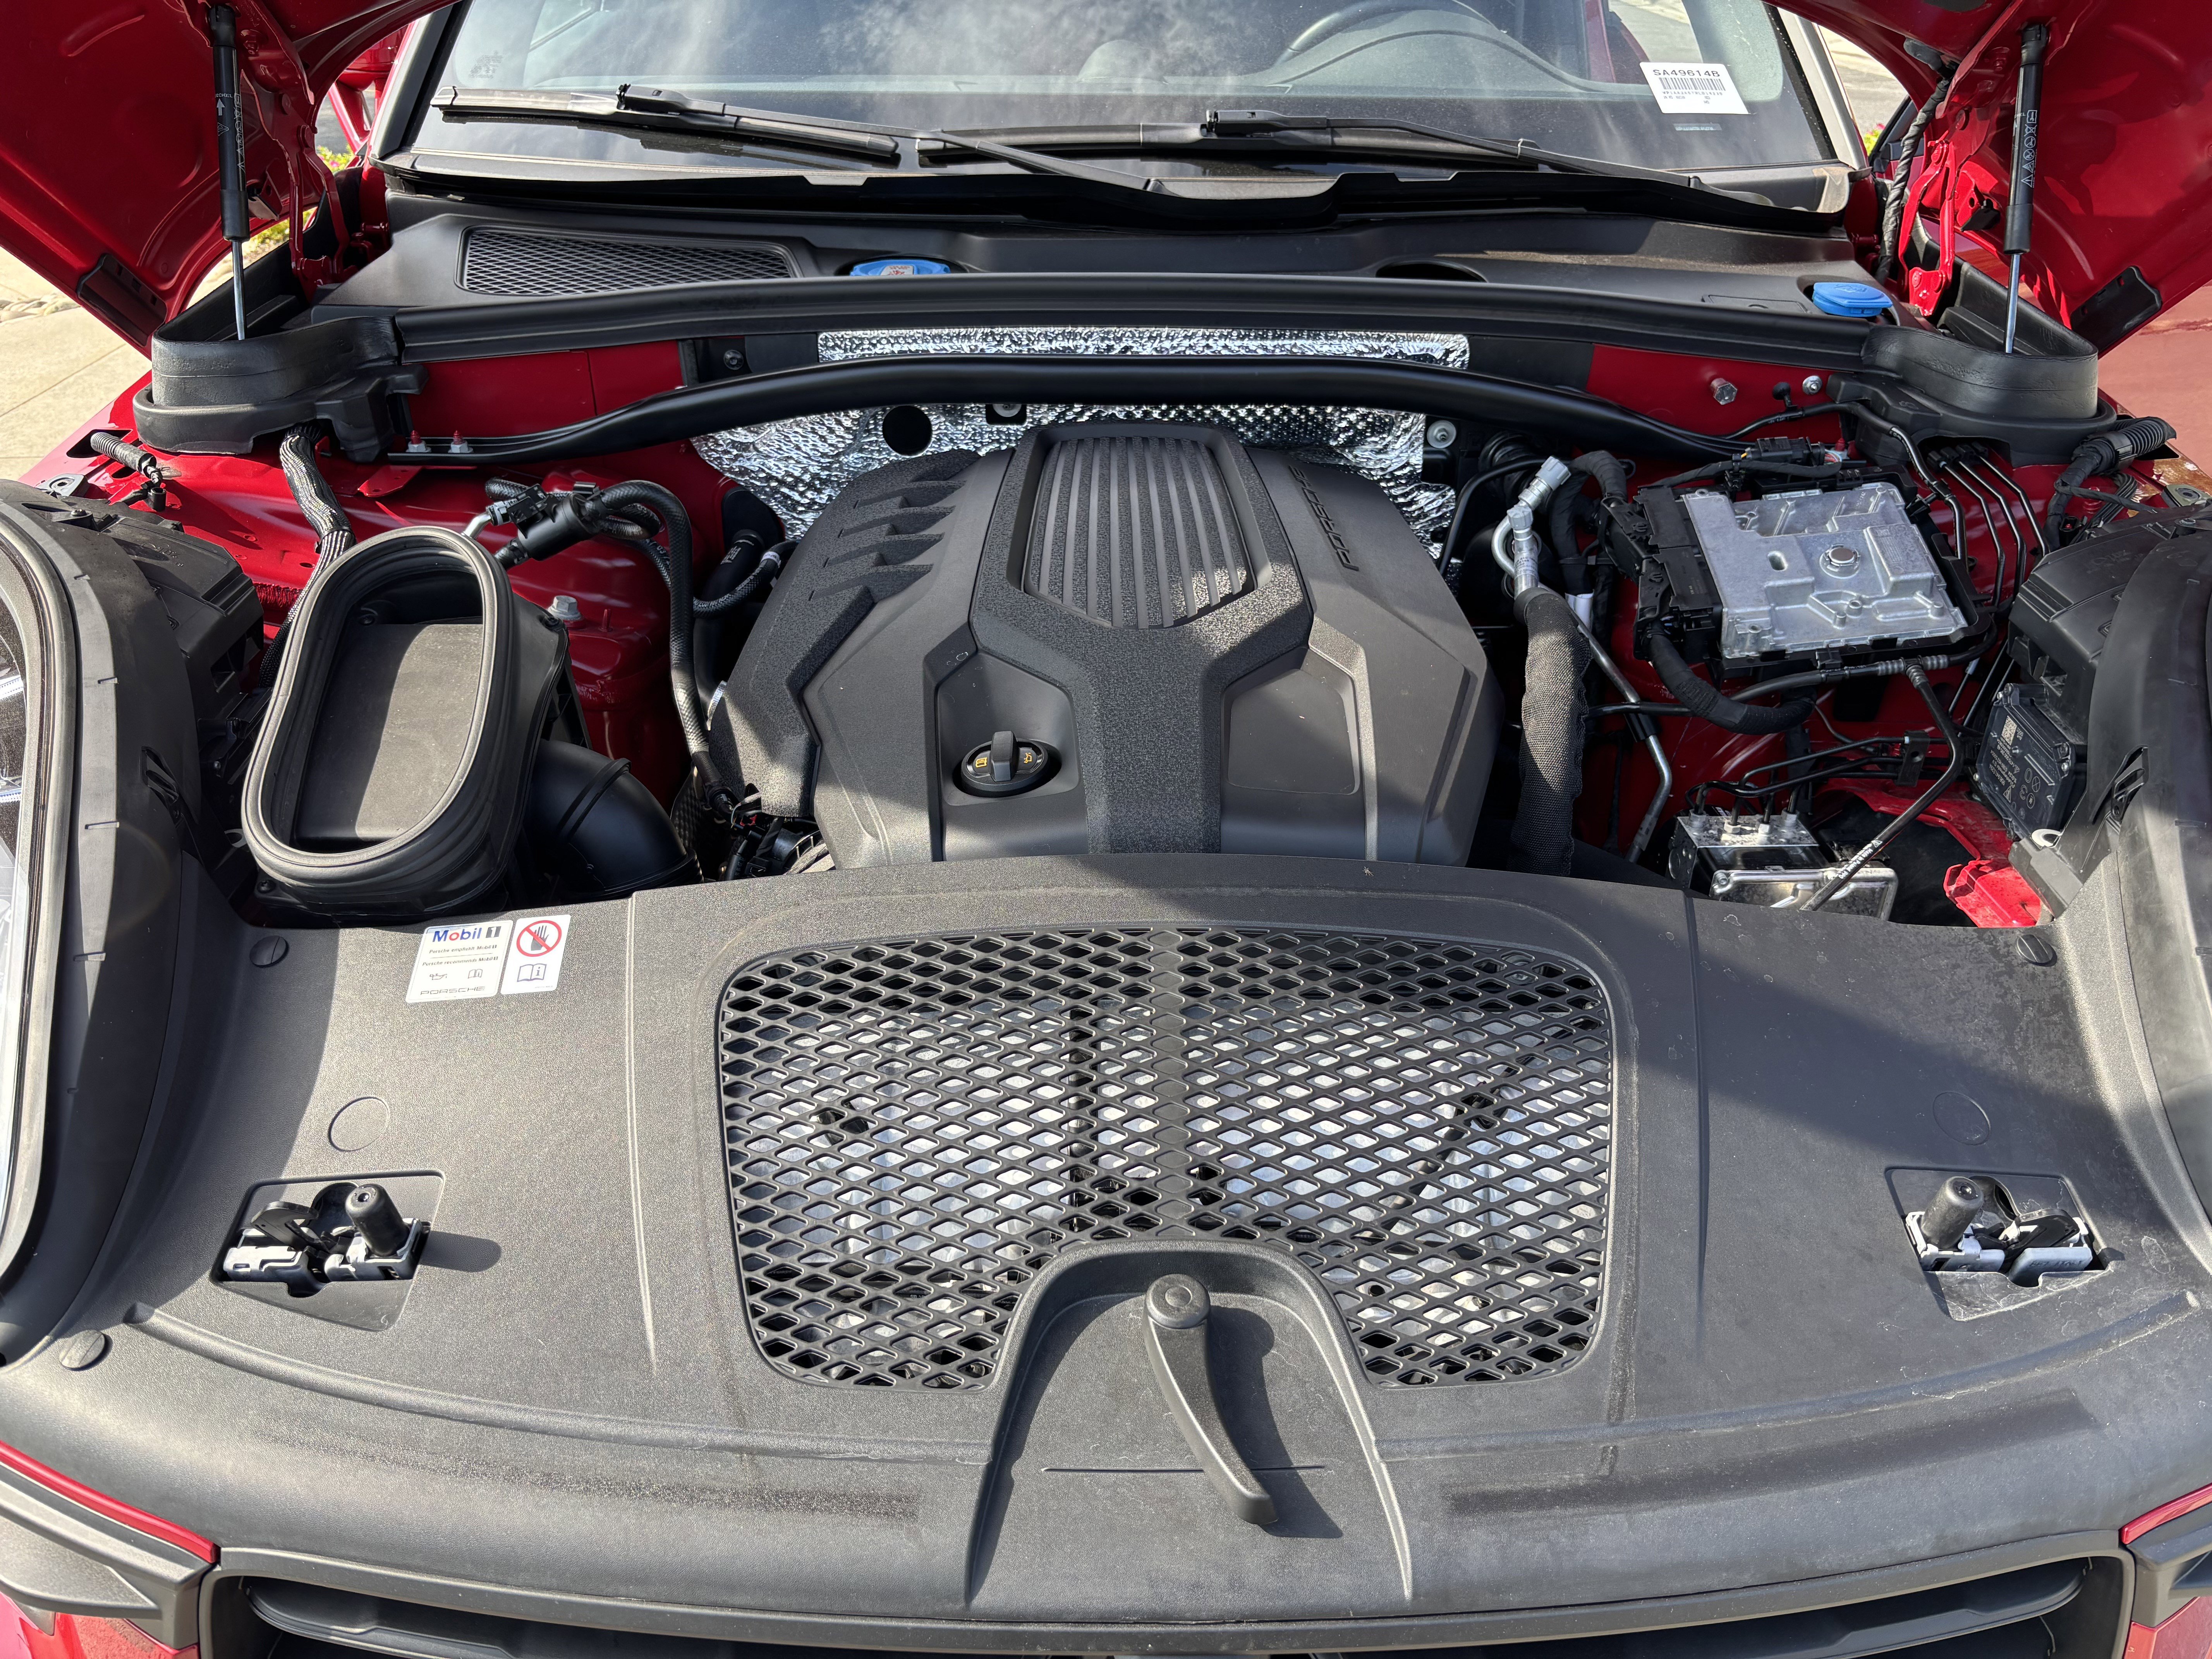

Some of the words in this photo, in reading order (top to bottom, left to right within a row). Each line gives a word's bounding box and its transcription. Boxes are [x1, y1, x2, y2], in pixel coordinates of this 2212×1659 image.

[1288, 465, 1359, 571] PORSCHE
[432, 927, 482, 942] Mobil
[420, 986, 485, 995] PORSCHE
